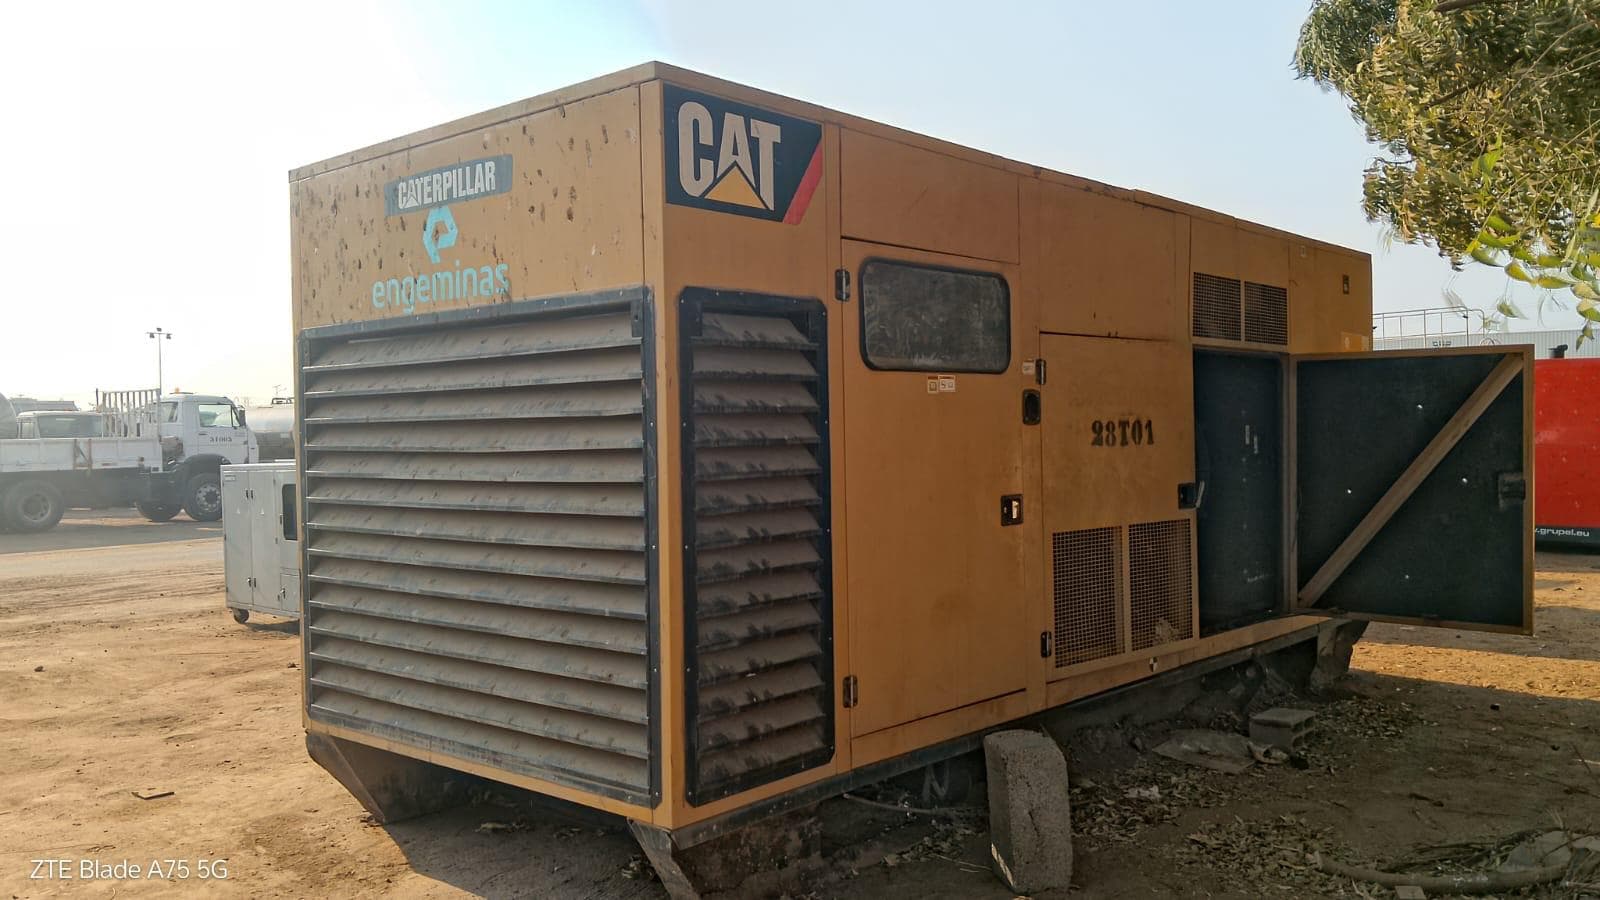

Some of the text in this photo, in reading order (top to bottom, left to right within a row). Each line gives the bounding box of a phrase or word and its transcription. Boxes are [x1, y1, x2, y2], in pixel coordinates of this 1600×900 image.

[678, 101, 781, 211] CAT
[398, 161, 496, 210] CATERPILLAR
[372, 260, 510, 315] engeminas
[1091, 419, 1154, 447] 28T01
